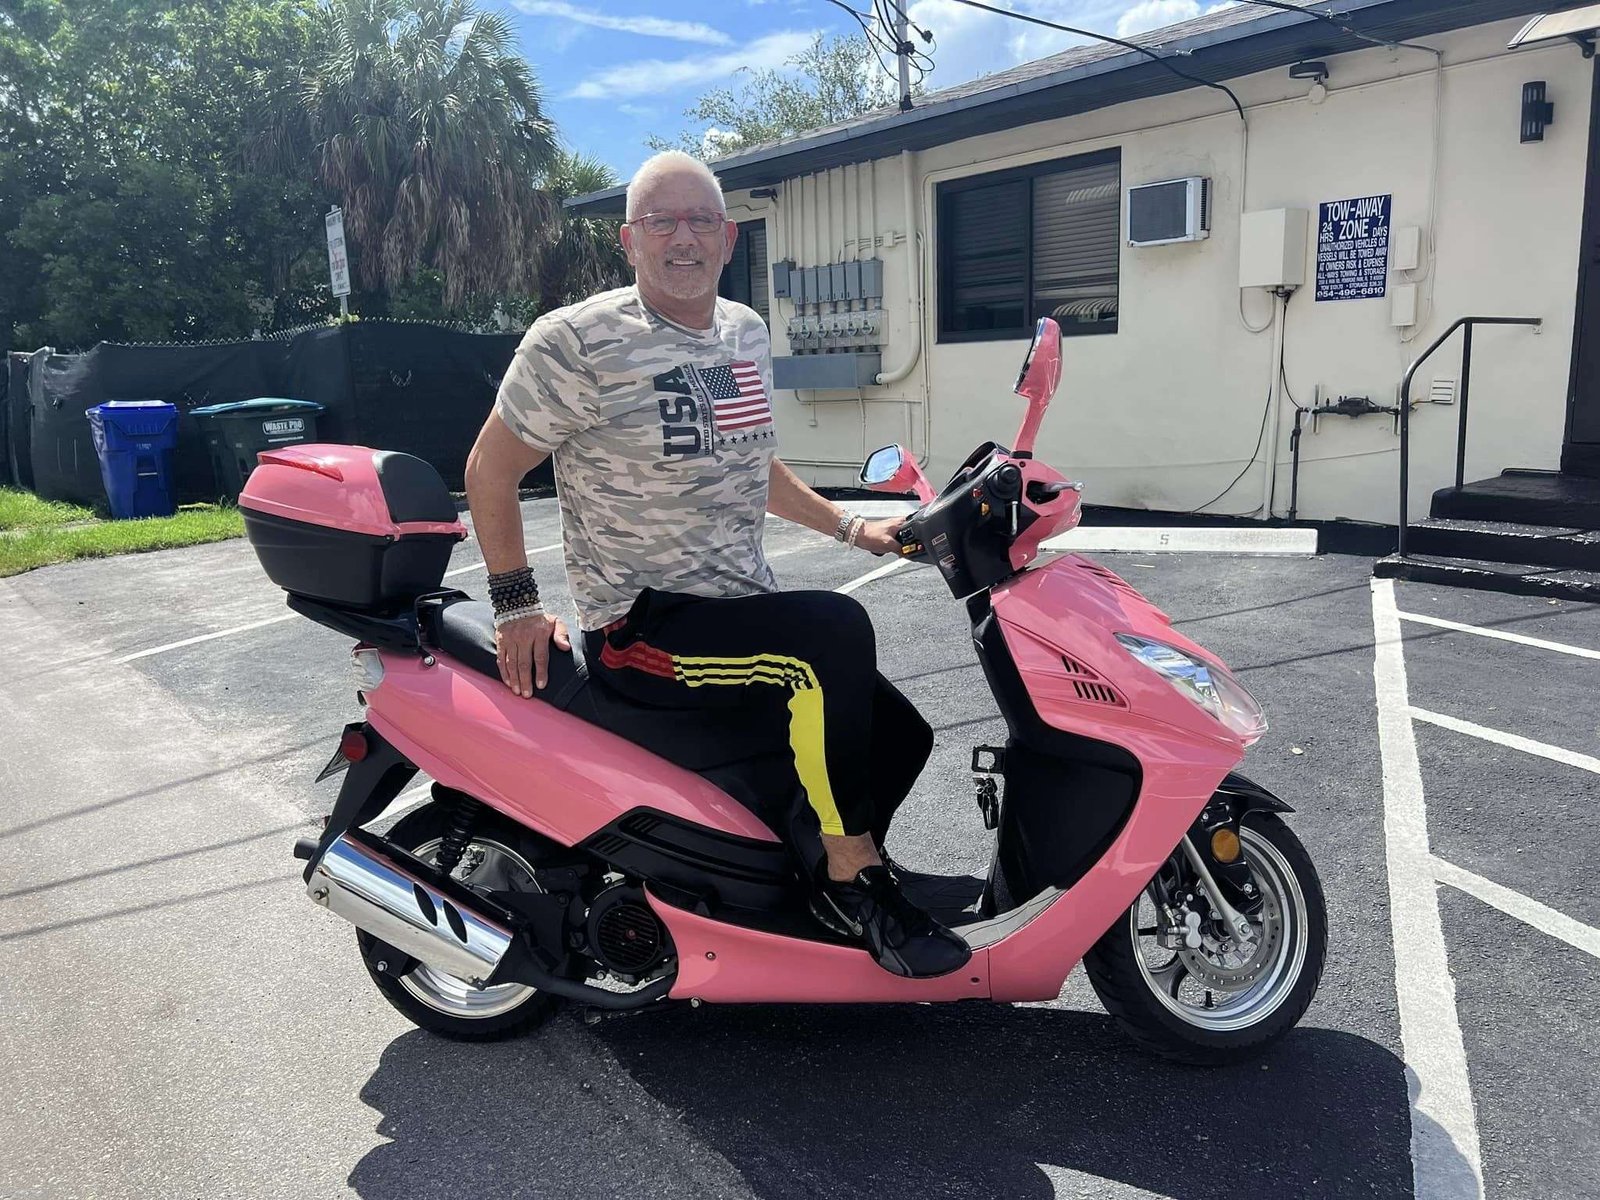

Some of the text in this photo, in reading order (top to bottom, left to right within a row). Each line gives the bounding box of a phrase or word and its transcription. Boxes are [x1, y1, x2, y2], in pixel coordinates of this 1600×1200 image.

[1327, 196, 1385, 221] TOW-AWAY
[1378, 216, 1385, 226] 7
[1322, 222, 1333, 233] 24
[1339, 218, 1369, 240] ZONE
[1372, 226, 1388, 237] DAYS
[1320, 232, 1334, 243] HRS
[1320, 237, 1386, 252] UNAUTHORIZED VEHICLES OR
[1318, 246, 1388, 262] VESSELS WILL BE TOWED AWAY
[1319, 262, 1325, 272] AT
[1346, 259, 1357, 269] RISK
[1363, 257, 1385, 268] EXPENSE
[1340, 269, 1357, 278] TOWING
[1364, 267, 1386, 275] STORAGE
[1317, 286, 1384, 298] 954-496-6810
[682, 364, 700, 392] AMERICA
[696, 394, 704, 403] OF
[653, 365, 701, 457] USA
[700, 402, 709, 428] STATES
[265, 421, 288, 431] WASTE
[1160, 534, 1170, 545] 5
